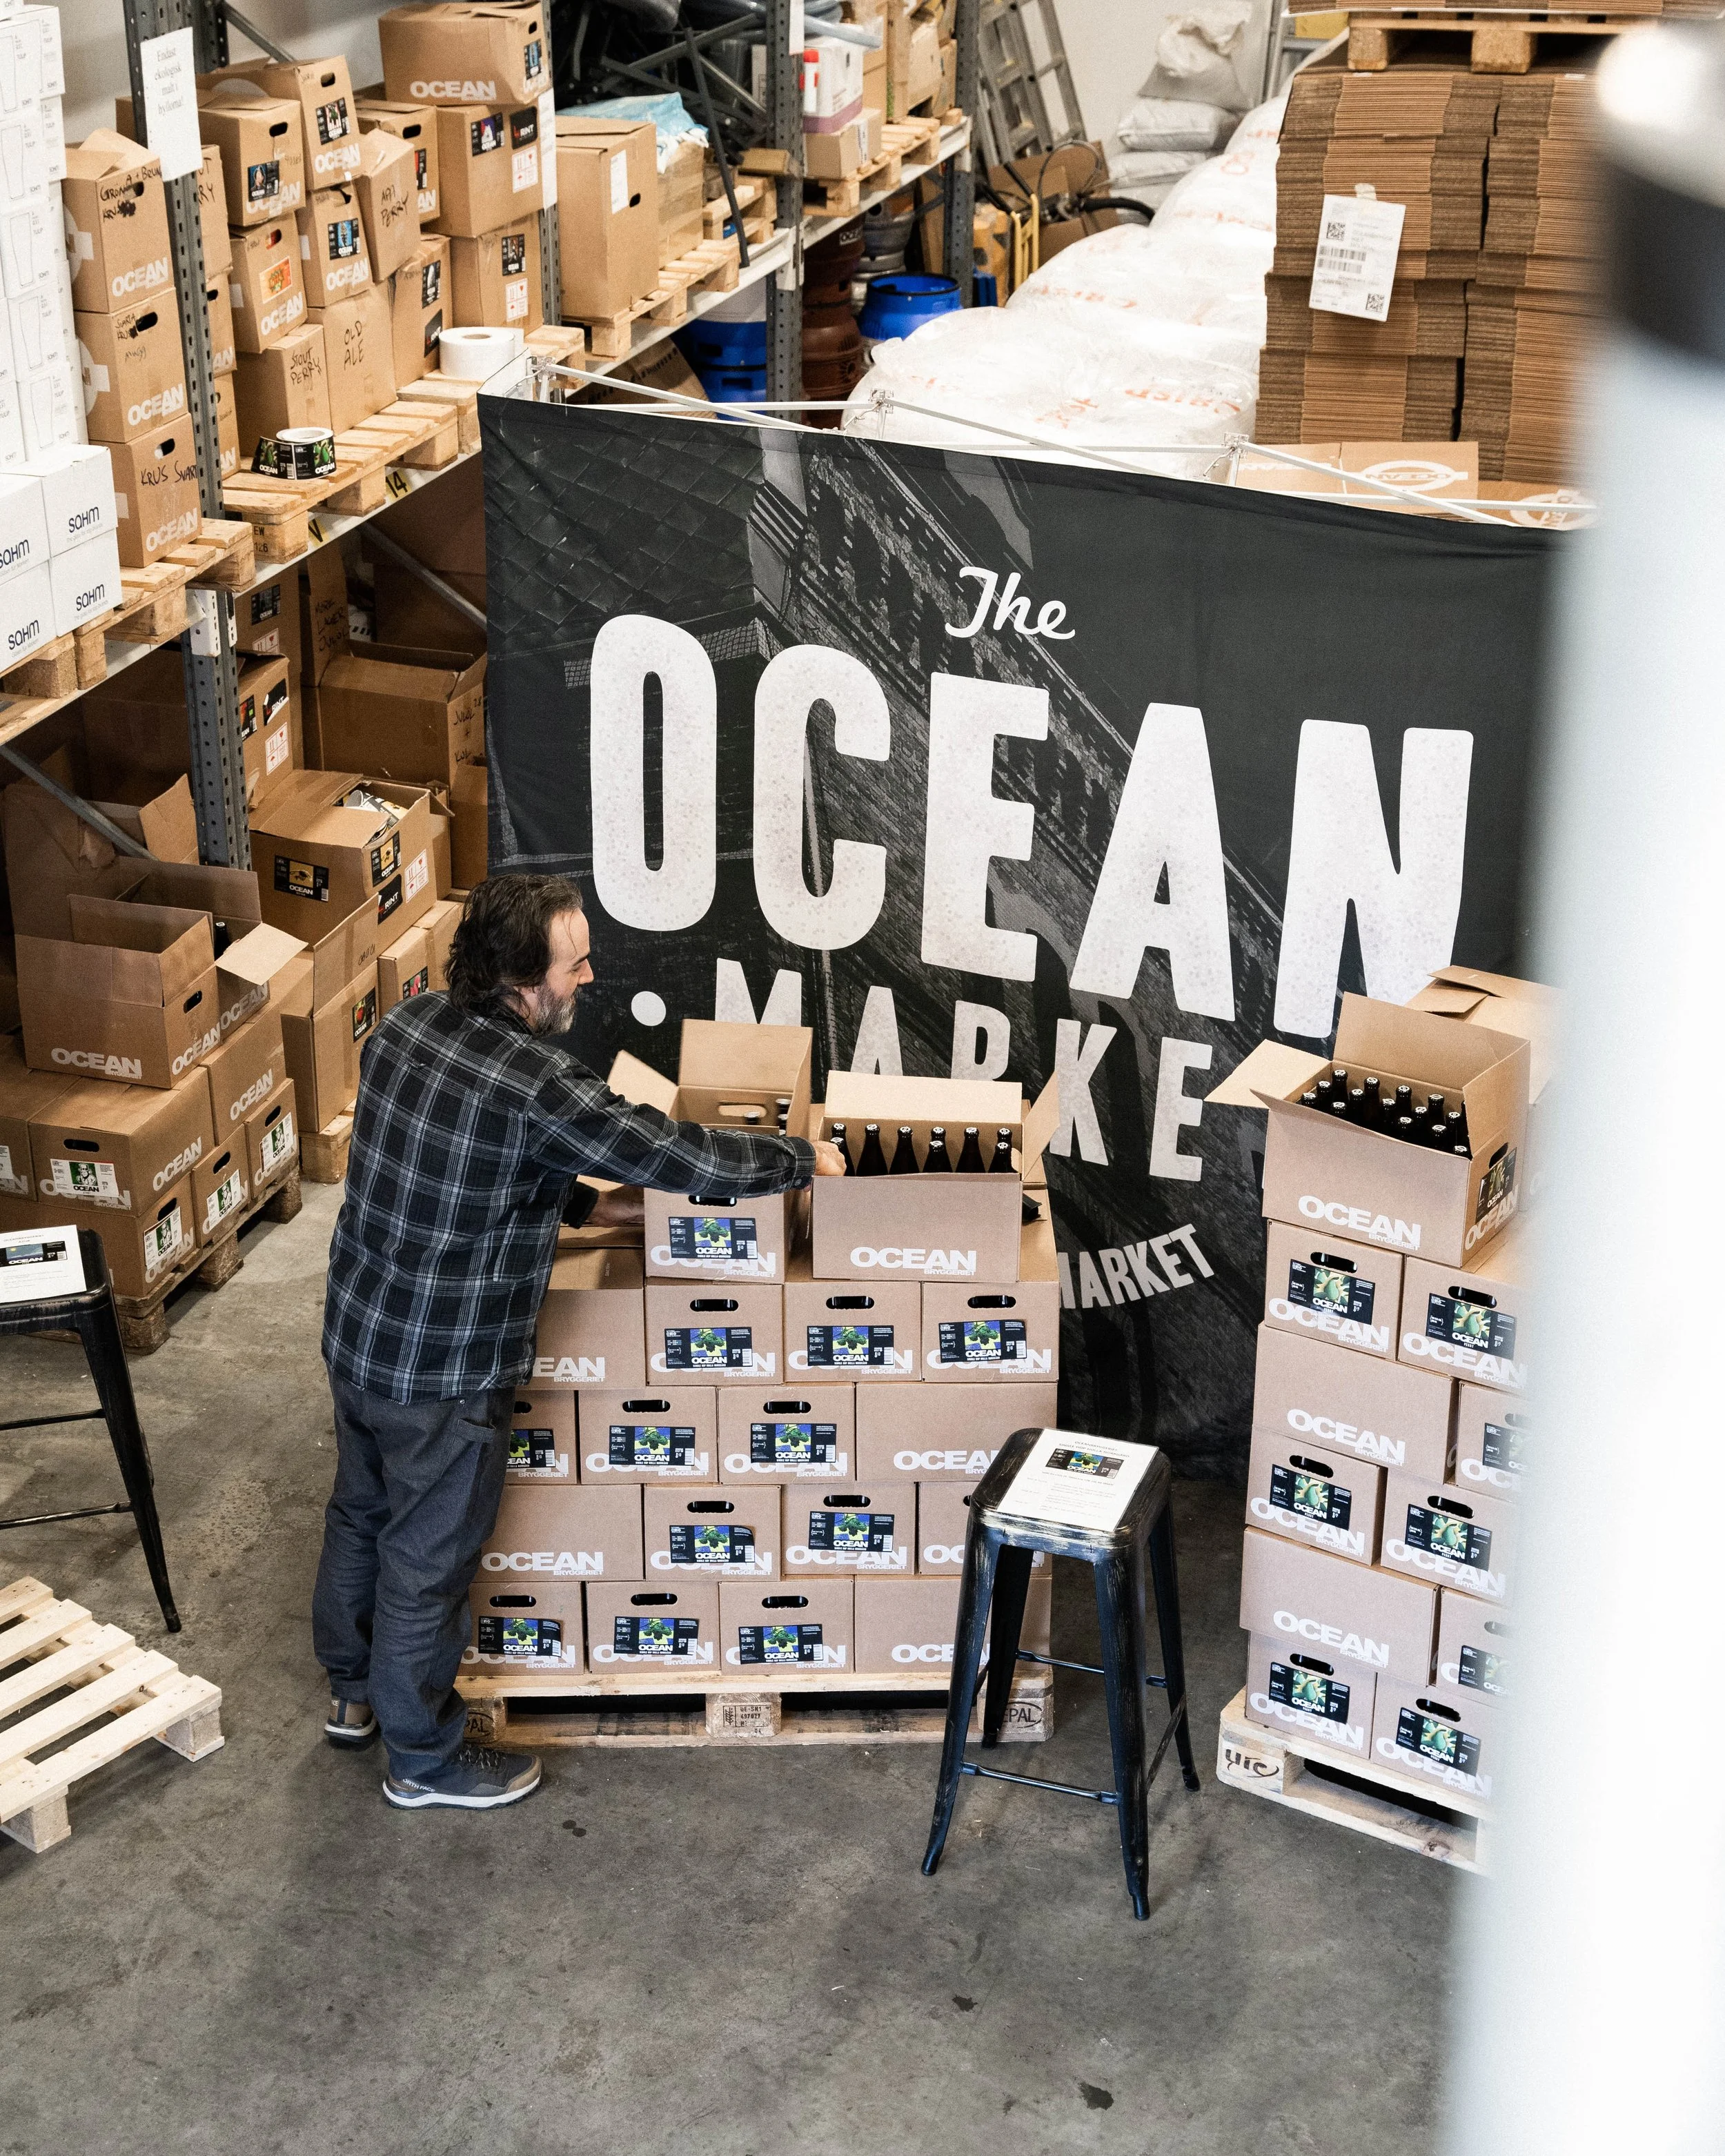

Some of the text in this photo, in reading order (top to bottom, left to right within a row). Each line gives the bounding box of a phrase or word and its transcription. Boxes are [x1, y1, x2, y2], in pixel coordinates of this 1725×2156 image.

[410, 80, 497, 100] OCEAN
[314, 143, 361, 174] OCEAN
[112, 257, 168, 297] OCEAN
[326, 257, 369, 291] OCEAN
[260, 291, 303, 336] OCEAN
[344, 320, 362, 346] OLD
[290, 346, 313, 370] STOUT
[128, 384, 184, 426] OCEAN
[141, 465, 168, 486] KRUS
[259, 464, 278, 475] OCEAN
[315, 462, 335, 475] OCEAN
[146, 507, 198, 552] OCEAN
[945, 565, 1077, 642] The
[591, 614, 1474, 1039] OCEAN
[382, 862, 395, 877] OCEAN
[289, 884, 313, 895] OCEAN
[220, 984, 268, 1030] OCEAN
[355, 1022, 367, 1037] OCEAN
[172, 1022, 221, 1076] OCEAN
[51, 1048, 142, 1078] OCEAN
[230, 1068, 273, 1120] OCEAN
[273, 1143, 286, 1158] OCEAN
[153, 1136, 201, 1191] OCEAN
[73, 1185, 99, 1193] OCEAN
[1488, 1189, 1504, 1208] OCEAN
[219, 1202, 233, 1217] OCEAN
[1299, 1196, 1421, 1246] OCEAN
[158, 1241, 172, 1256] OCEAN
[696, 1247, 732, 1255] OCEAN
[1368, 1233, 1421, 1251] BRYGGERIET
[850, 1246, 977, 1269] OCEAN
[724, 1269, 776, 1278] BRYGGERIET
[1312, 1298, 1348, 1314] OCEAN
[1269, 1298, 1389, 1349] OCEAN
[1338, 1335, 1389, 1353] BRYGGERIET
[1452, 1332, 1488, 1349] OCEAN
[691, 1356, 727, 1365] OCEAN
[965, 1349, 1001, 1358] OCEAN
[1403, 1332, 1527, 1385] OCEAN
[532, 1357, 605, 1378] EAN
[1288, 1409, 1406, 1460] OCEAN
[1355, 1448, 1405, 1467] BRYGGERIET
[1294, 1502, 1327, 1519] OCEAN
[1250, 1498, 1365, 1550] OCEAN
[834, 1540, 869, 1548] OCEAN
[1316, 1537, 1364, 1557] BRYGGERIET
[1430, 1542, 1466, 1559] OCEAN
[482, 1552, 604, 1572] OCEAN
[1386, 1539, 1506, 1593] OCEAN
[1274, 1610, 1389, 1663] OCEAN
[1340, 1648, 1389, 1668] BRYGGERIET
[1292, 1697, 1325, 1713] OCEAN
[1250, 1692, 1363, 1745] OCEAN
[1315, 1730, 1363, 1750] BRYGGERIET
[1420, 1743, 1454, 1764] OCEAN
[1376, 1737, 1492, 1794] OCEAN
